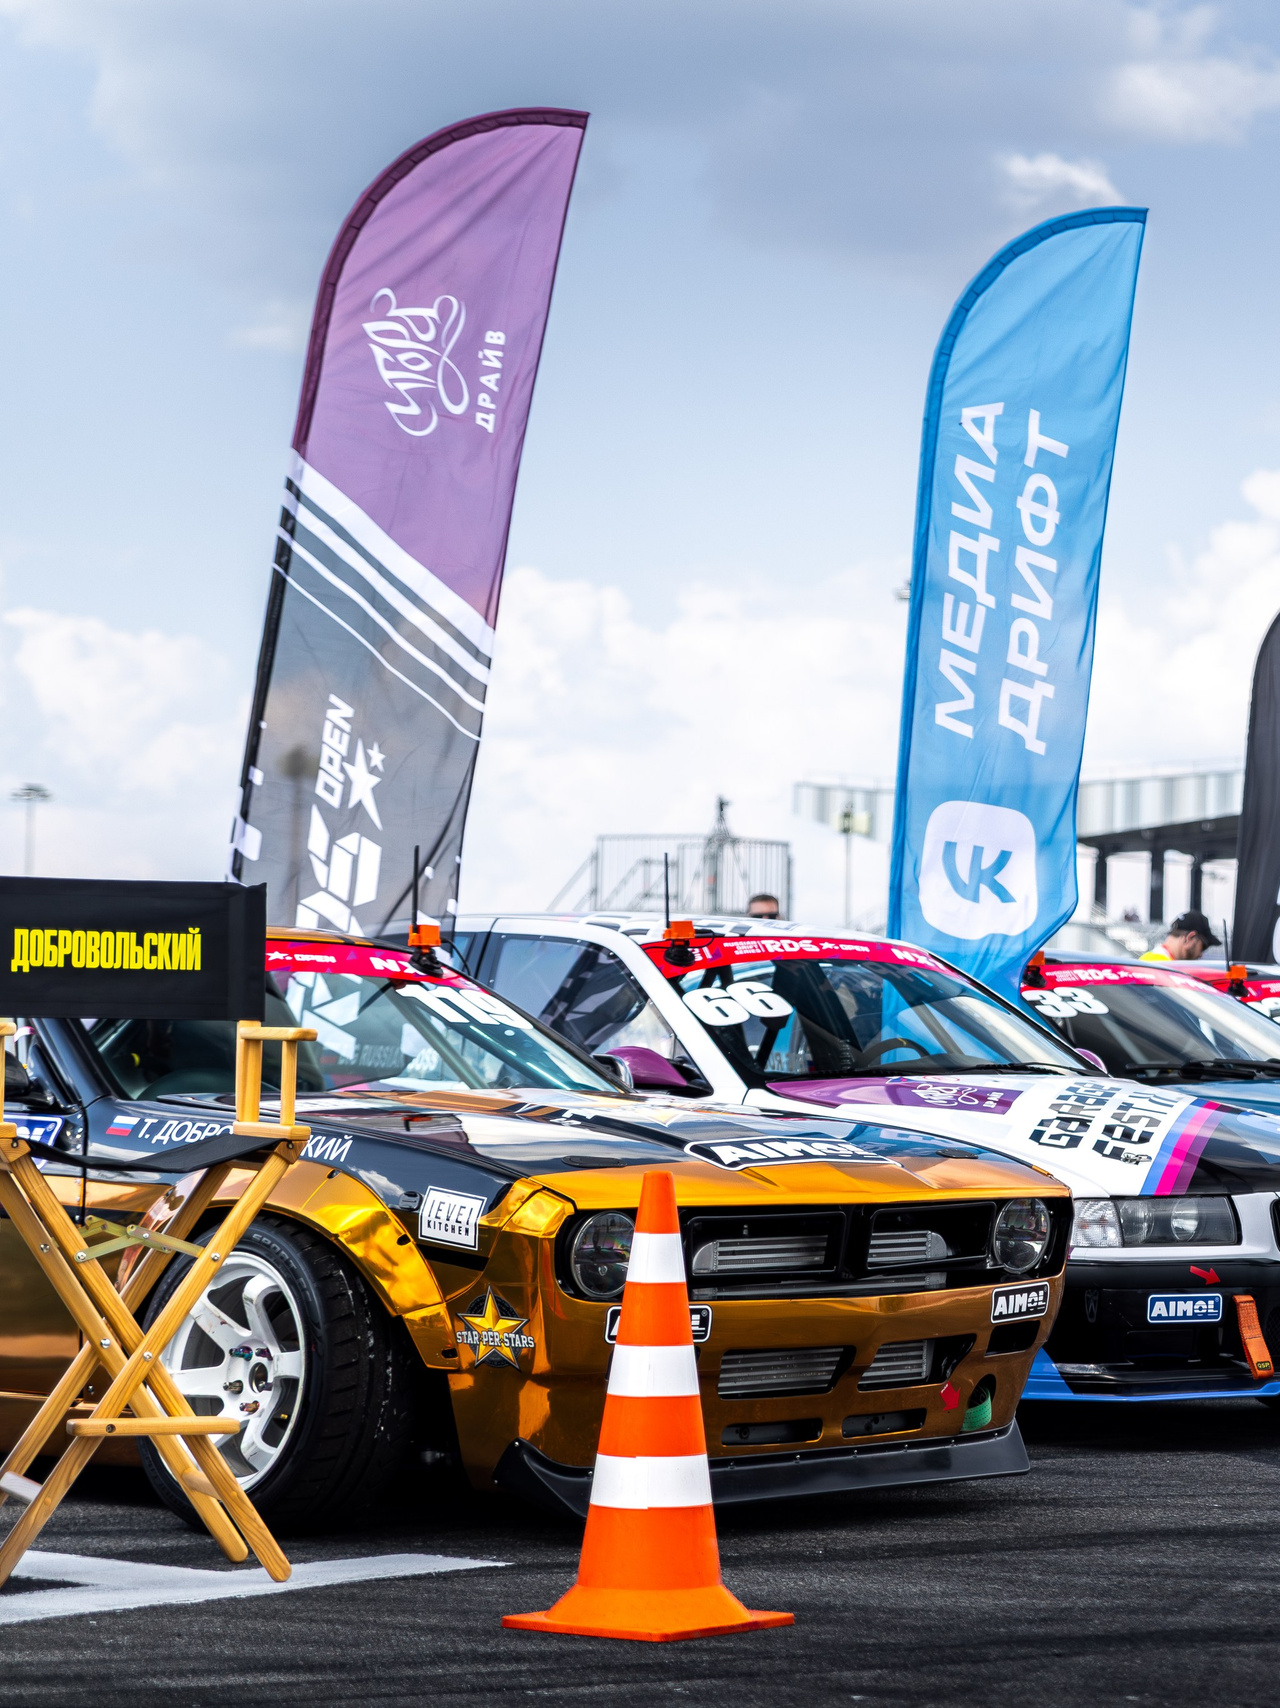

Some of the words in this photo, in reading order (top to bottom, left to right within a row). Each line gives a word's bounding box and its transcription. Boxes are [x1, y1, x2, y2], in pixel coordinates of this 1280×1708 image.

[475, 330, 506, 433] ДРАЙВ
[934, 401, 1004, 739] МЕДИА
[998, 408, 1070, 757] ДРИФТ
[314, 693, 355, 809] OPEN
[11, 926, 201, 973] ДОБРОВОЛЬСКИЙ
[761, 939, 820, 953] RDS
[396, 984, 533, 1030] 119
[682, 981, 794, 1027] 66
[1021, 986, 1109, 1018] 33
[427, 1220, 469, 1237] KITCHEN
[994, 1290, 1046, 1316] AIMOL
[1151, 1300, 1218, 1317] AIMOL
[456, 1330, 480, 1344] STAR
[503, 1332, 535, 1348] STARS
